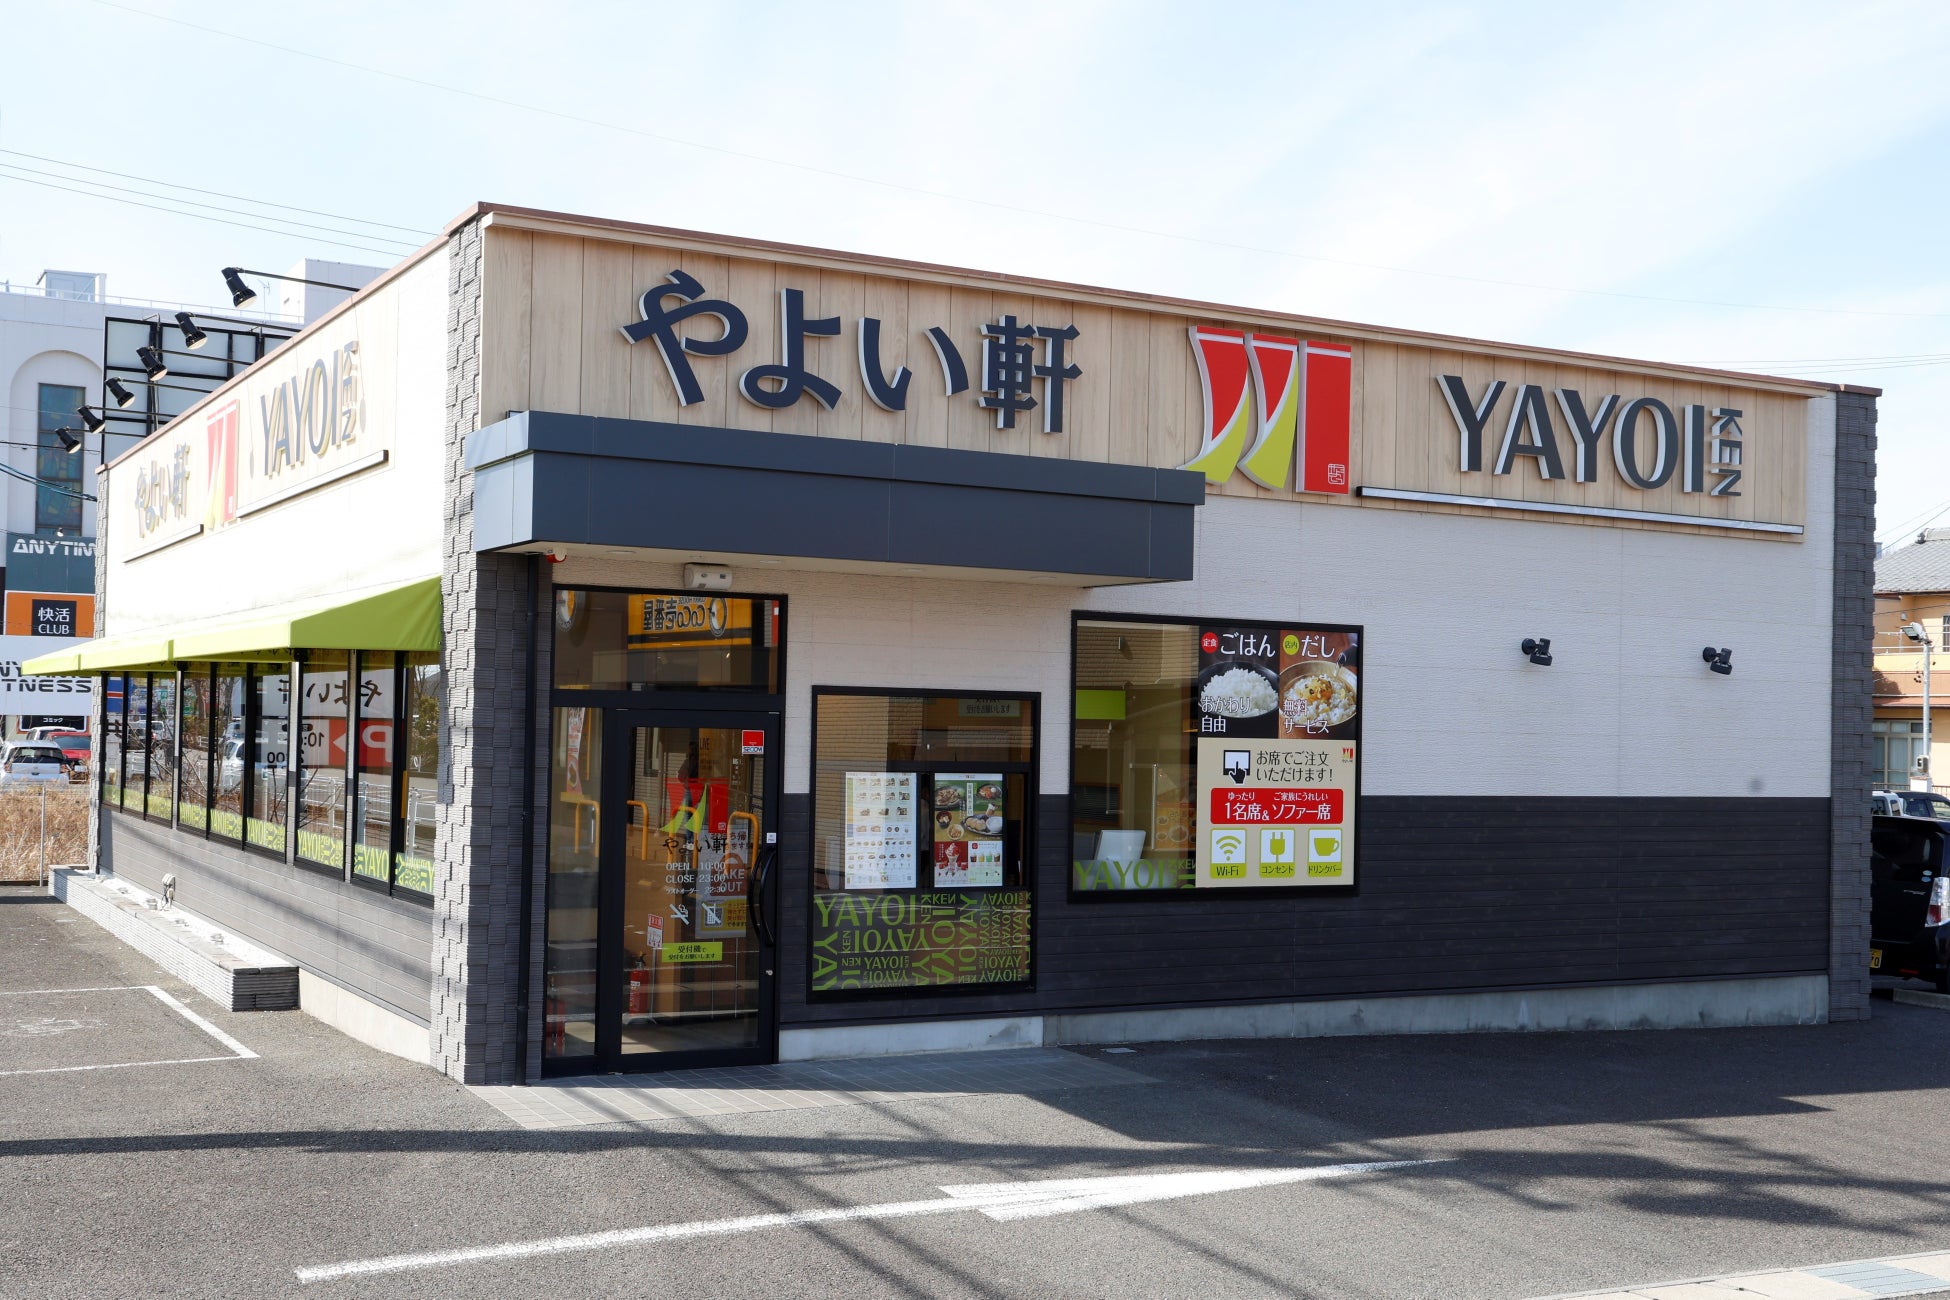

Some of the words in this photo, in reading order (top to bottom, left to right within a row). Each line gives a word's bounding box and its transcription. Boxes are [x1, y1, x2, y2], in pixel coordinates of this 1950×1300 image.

[619, 268, 1083, 433] やよい軒
[260, 348, 343, 480] YAYOI
[341, 340, 359, 446] KEN
[1436, 373, 1705, 492] YAYOI
[1710, 407, 1743, 497] KEN
[135, 443, 191, 539] やよい軒
[38, 607, 70, 622] 快活
[38, 624, 69, 635] CLUB
[1202, 638, 1217, 648] 定食
[1220, 631, 1276, 658] ごはん
[1301, 635, 1335, 658] だし
[1201, 696, 1252, 713] おかわり
[1283, 699, 1308, 717] 無料
[1201, 715, 1227, 733] 自由
[1284, 718, 1330, 734] サービス
[1256, 750, 1330, 766] お席でご注文
[1227, 792, 1255, 801] ゆったり
[1274, 792, 1328, 802] ご家族にうれしい
[665, 862, 690, 871] OPEN
[700, 862, 726, 871] 10:00
[1073, 859, 1165, 890] YAYOI
[1216, 866, 1239, 876] Wi-Fi
[1261, 865, 1294, 874] コンセント
[1308, 865, 1341, 874] ドリンクバー
[665, 874, 695, 883] CLOSE
[699, 874, 726, 883] 23:00
[814, 894, 916, 928] YAYOI
[864, 956, 904, 969] YAYOI
